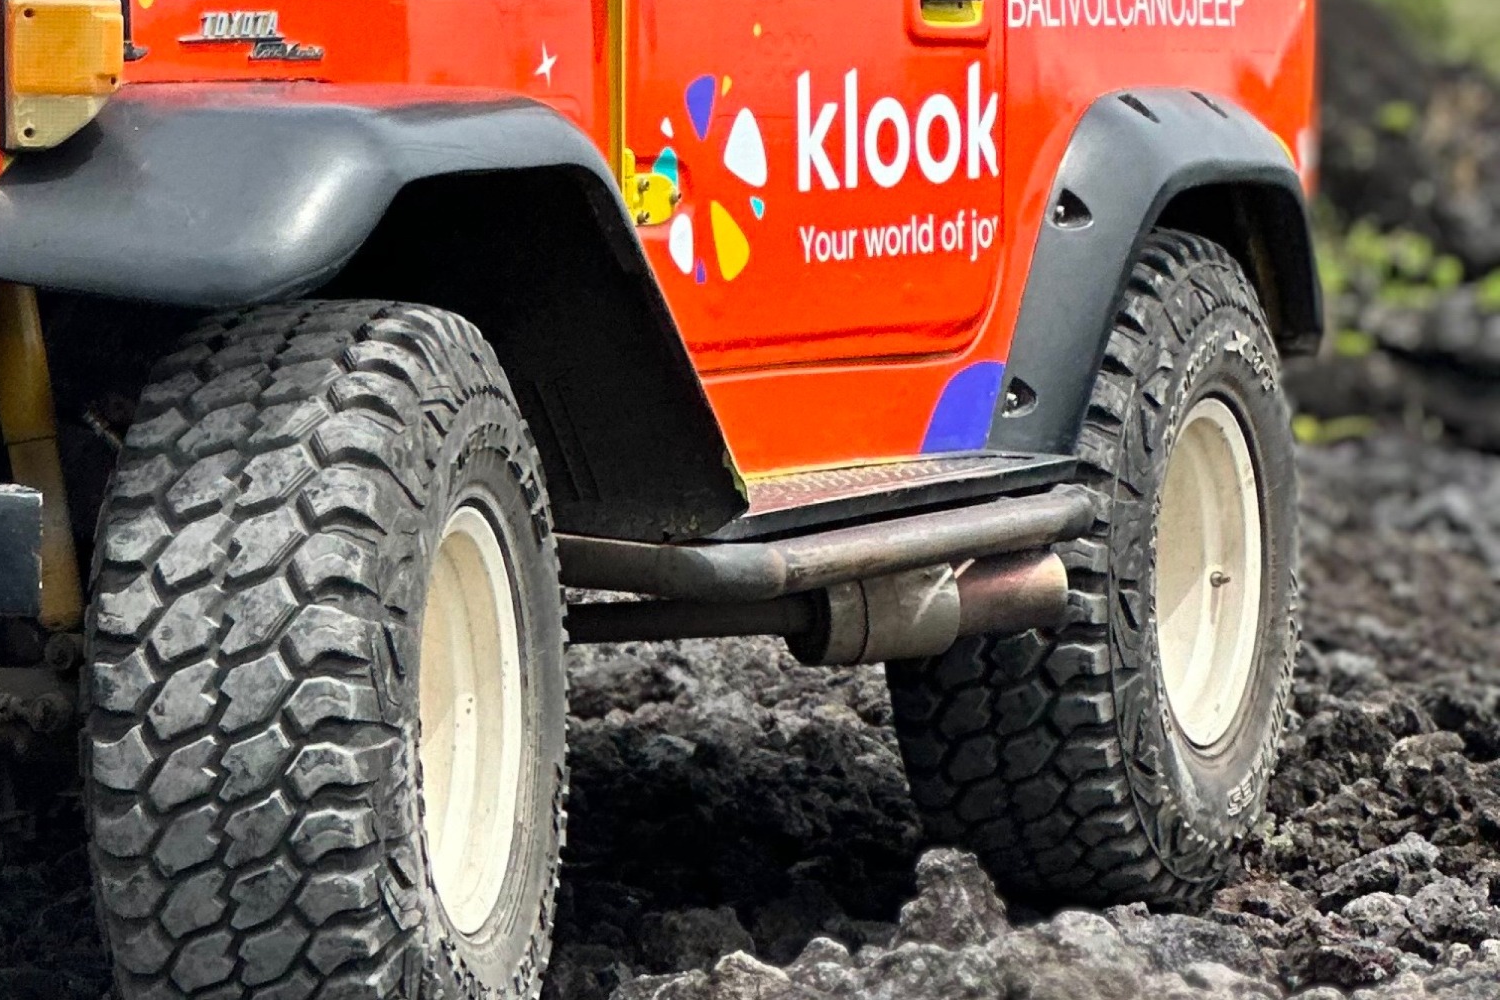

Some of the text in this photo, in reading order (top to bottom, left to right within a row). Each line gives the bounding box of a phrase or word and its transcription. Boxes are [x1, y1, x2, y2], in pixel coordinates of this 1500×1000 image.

[201, 10, 279, 37] TOYOTA
[797, 61, 999, 191] klook
[799, 225, 858, 264] Your
[864, 213, 934, 257] world
[941, 209, 965, 250] of
